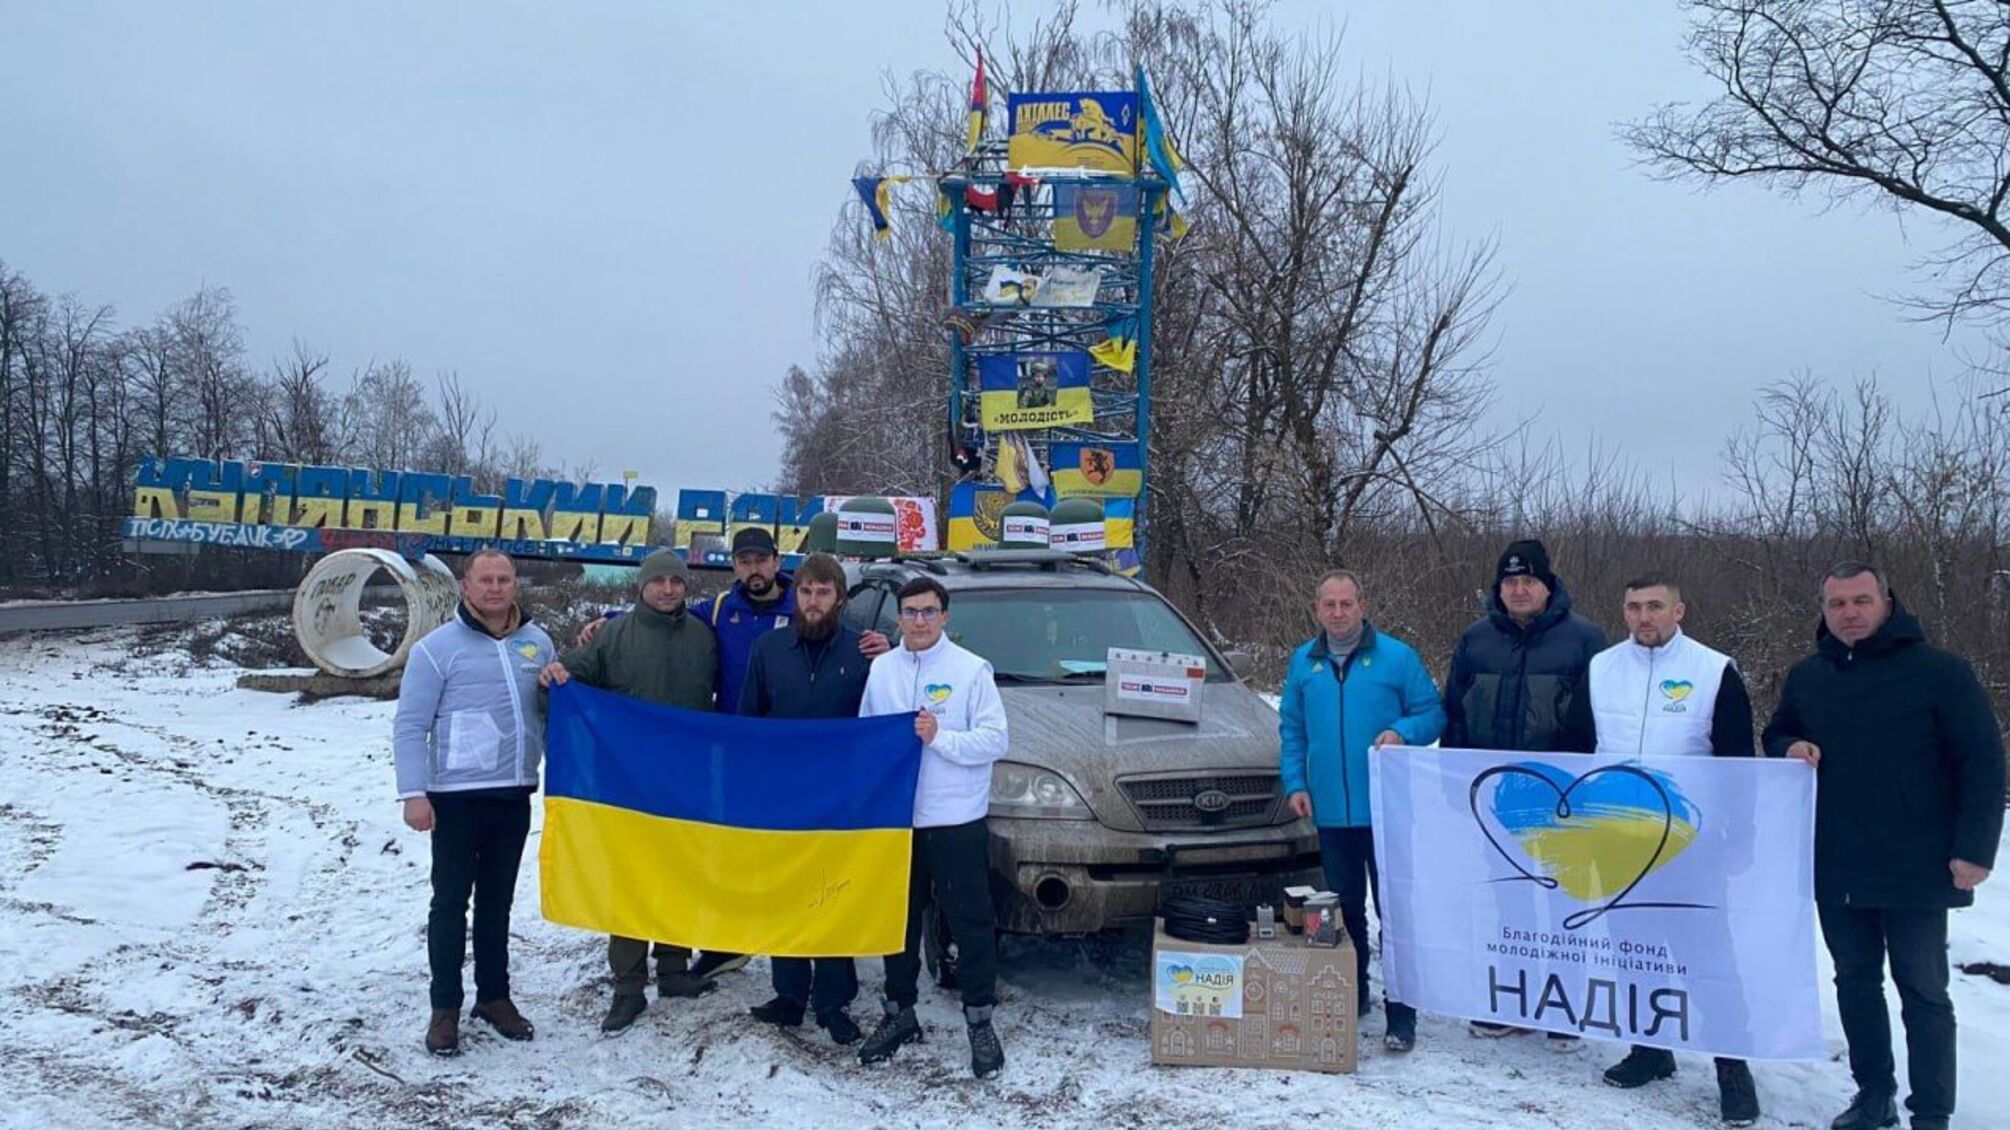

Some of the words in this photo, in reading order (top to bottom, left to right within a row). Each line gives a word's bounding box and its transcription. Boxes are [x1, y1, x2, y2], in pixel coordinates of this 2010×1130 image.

[1201, 795, 1225, 806] KIA
[1503, 927, 1611, 951] Благодійний
[1619, 939, 1668, 959] фонд
[1487, 943, 1587, 963] молодіжної
[1594, 954, 1687, 976] ініціативи
[1195, 973, 1234, 985] НАДІЯ
[1488, 965, 1688, 1042] НАДІЯ
